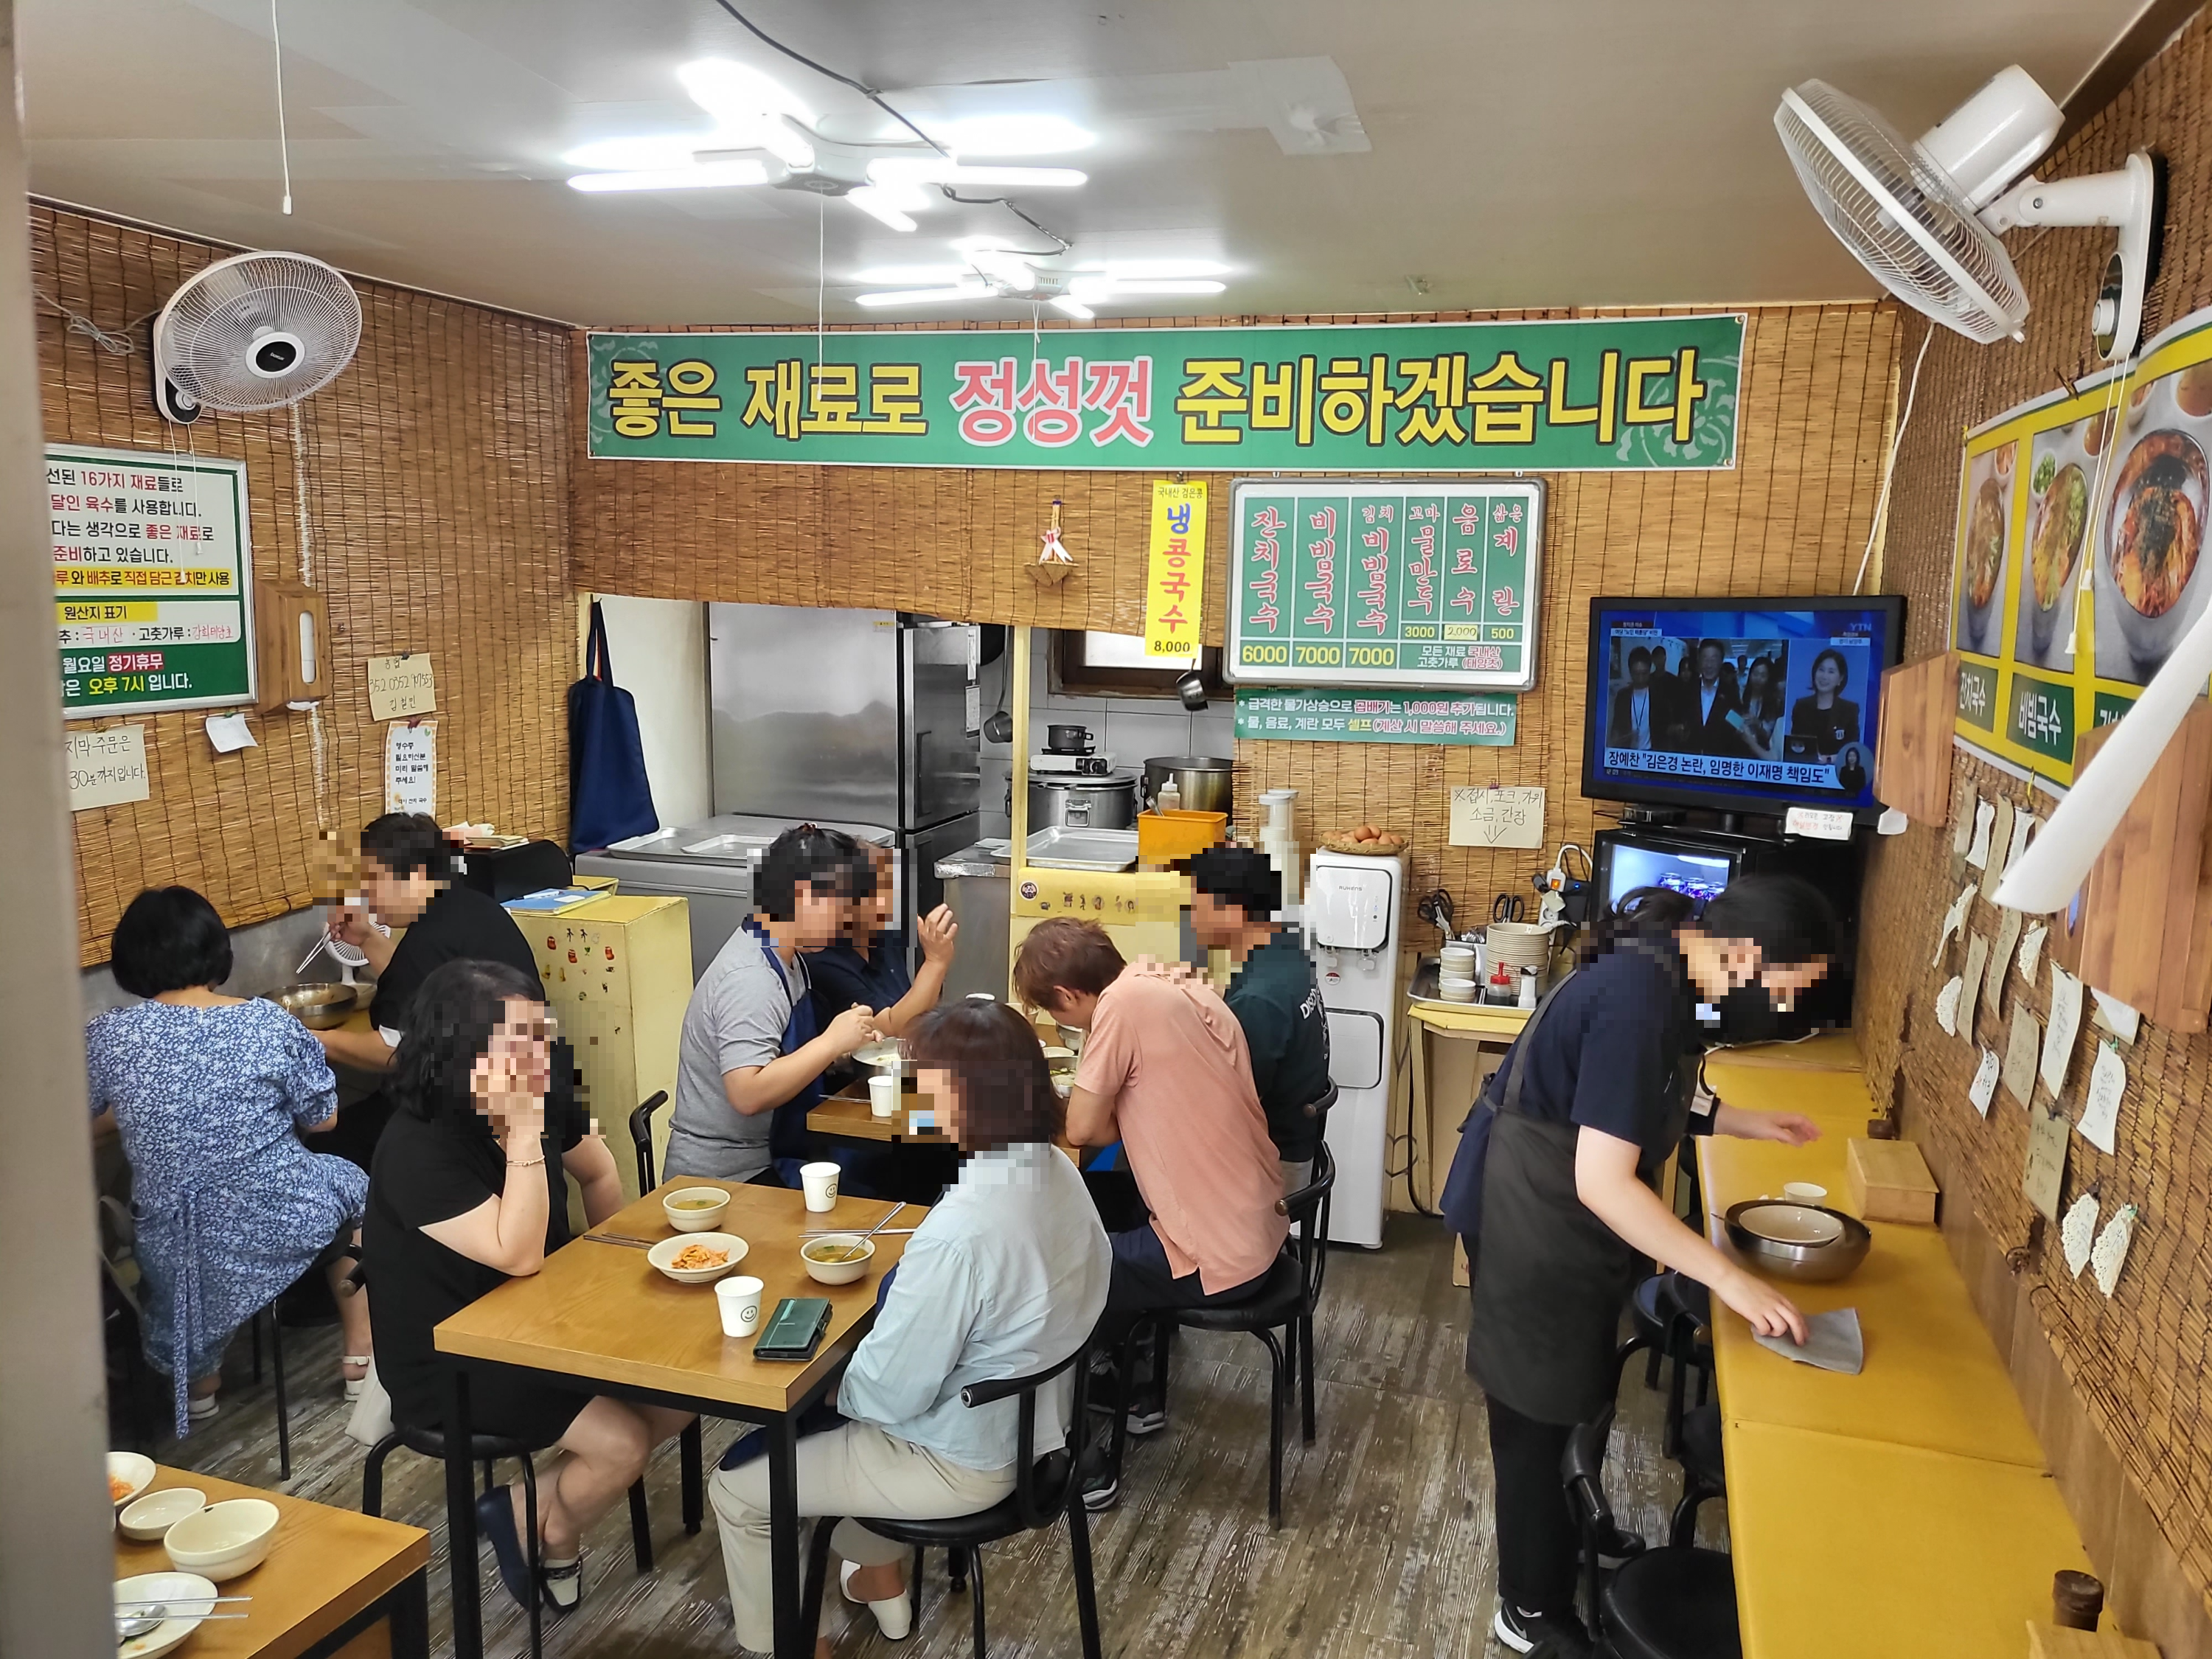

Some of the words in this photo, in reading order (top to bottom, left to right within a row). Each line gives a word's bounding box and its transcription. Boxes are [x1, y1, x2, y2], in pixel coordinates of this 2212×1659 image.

[608, 357, 723, 440] 좋은
[741, 357, 929, 441] 재료로
[949, 355, 1153, 448] 정성껏
[1175, 346, 1706, 448] 준비하겠습니다
[80, 470, 125, 489] 16가지
[131, 474, 184, 493] 재료들로
[1158, 487, 1180, 498] 국내산
[1181, 487, 1203, 499] 검은콩
[51, 494, 80, 512] 달인
[86, 496, 128, 513] 육수를
[132, 498, 202, 518] 사용합니다.
[1362, 504, 1394, 524] 김치
[1409, 503, 1441, 522] 꼬마
[1492, 504, 1523, 523] 삶은
[86, 521, 141, 539] 생각으로
[145, 524, 172, 540] 좋은
[176, 525, 215, 541] 재료로
[53, 546, 111, 562] 준비하고
[116, 547, 173, 563] 있습니다.
[53, 570, 69, 585] 루
[71, 571, 85, 585] 와
[86, 570, 123, 585] 배추로
[124, 571, 147, 585] 직접
[149, 571, 172, 585] 담근
[208, 571, 230, 586] 사용
[1158, 502, 1192, 634] 냉콩국수
[1249, 506, 1286, 634] 잔치국수
[1304, 506, 1337, 635] 비빔국수
[1408, 525, 1438, 616] 물만두
[1357, 526, 1389, 636] 비빔국수
[64, 605, 101, 620] 원산지
[104, 605, 128, 619] 표기
[139, 627, 184, 641] 고춧가루
[1405, 626, 1435, 639] 3000
[1491, 628, 1514, 639] 500
[1850, 623, 1872, 631] YTN
[1154, 640, 1191, 653] 8,000
[1242, 645, 1288, 664] 6000
[1295, 646, 1340, 664] 7000
[1349, 647, 1395, 666] 7000
[1422, 645, 1443, 657] 모든
[1445, 646, 1467, 657] 재료
[1467, 646, 1502, 658] 국내산
[63, 656, 105, 674] 월요일
[108, 653, 164, 672] 정기휴무
[1417, 656, 1459, 669] 고춧가루
[1461, 657, 1503, 671] (태양초)
[88, 678, 118, 695] 오후
[121, 675, 145, 693] 7시
[148, 672, 192, 692] 입니다.
[369, 677, 387, 695] 352
[389, 675, 410, 691] 0352
[1959, 671, 1986, 717] 잔치국수
[1248, 698, 1283, 712] 급격한
[1284, 698, 1353, 714] 물가상승으로
[1354, 700, 1402, 715] 곱배기는
[1403, 701, 1449, 716] 1,000원
[1450, 702, 1514, 717] 추가됩니다.
[1247, 717, 1263, 730] 물,
[1264, 717, 1292, 731] 음료,
[1295, 718, 1319, 731] 계란
[1321, 718, 1345, 732] 모두
[1404, 720, 1417, 733] 시
[1419, 720, 1458, 735] 말씀해
[1459, 721, 1507, 737] 주세요.)
[2018, 690, 2062, 746] 비빔국수
[92, 734, 131, 754] 주문은
[1608, 751, 1641, 768] 장예찬
[1642, 753, 1678, 771] "김은경
[1680, 757, 1707, 776] 논란,
[1710, 761, 1745, 778] 임명한
[1747, 762, 1784, 781] 이재명
[1786, 765, 1830, 785] 책임도"
[1500, 806, 1526, 826] 간장
